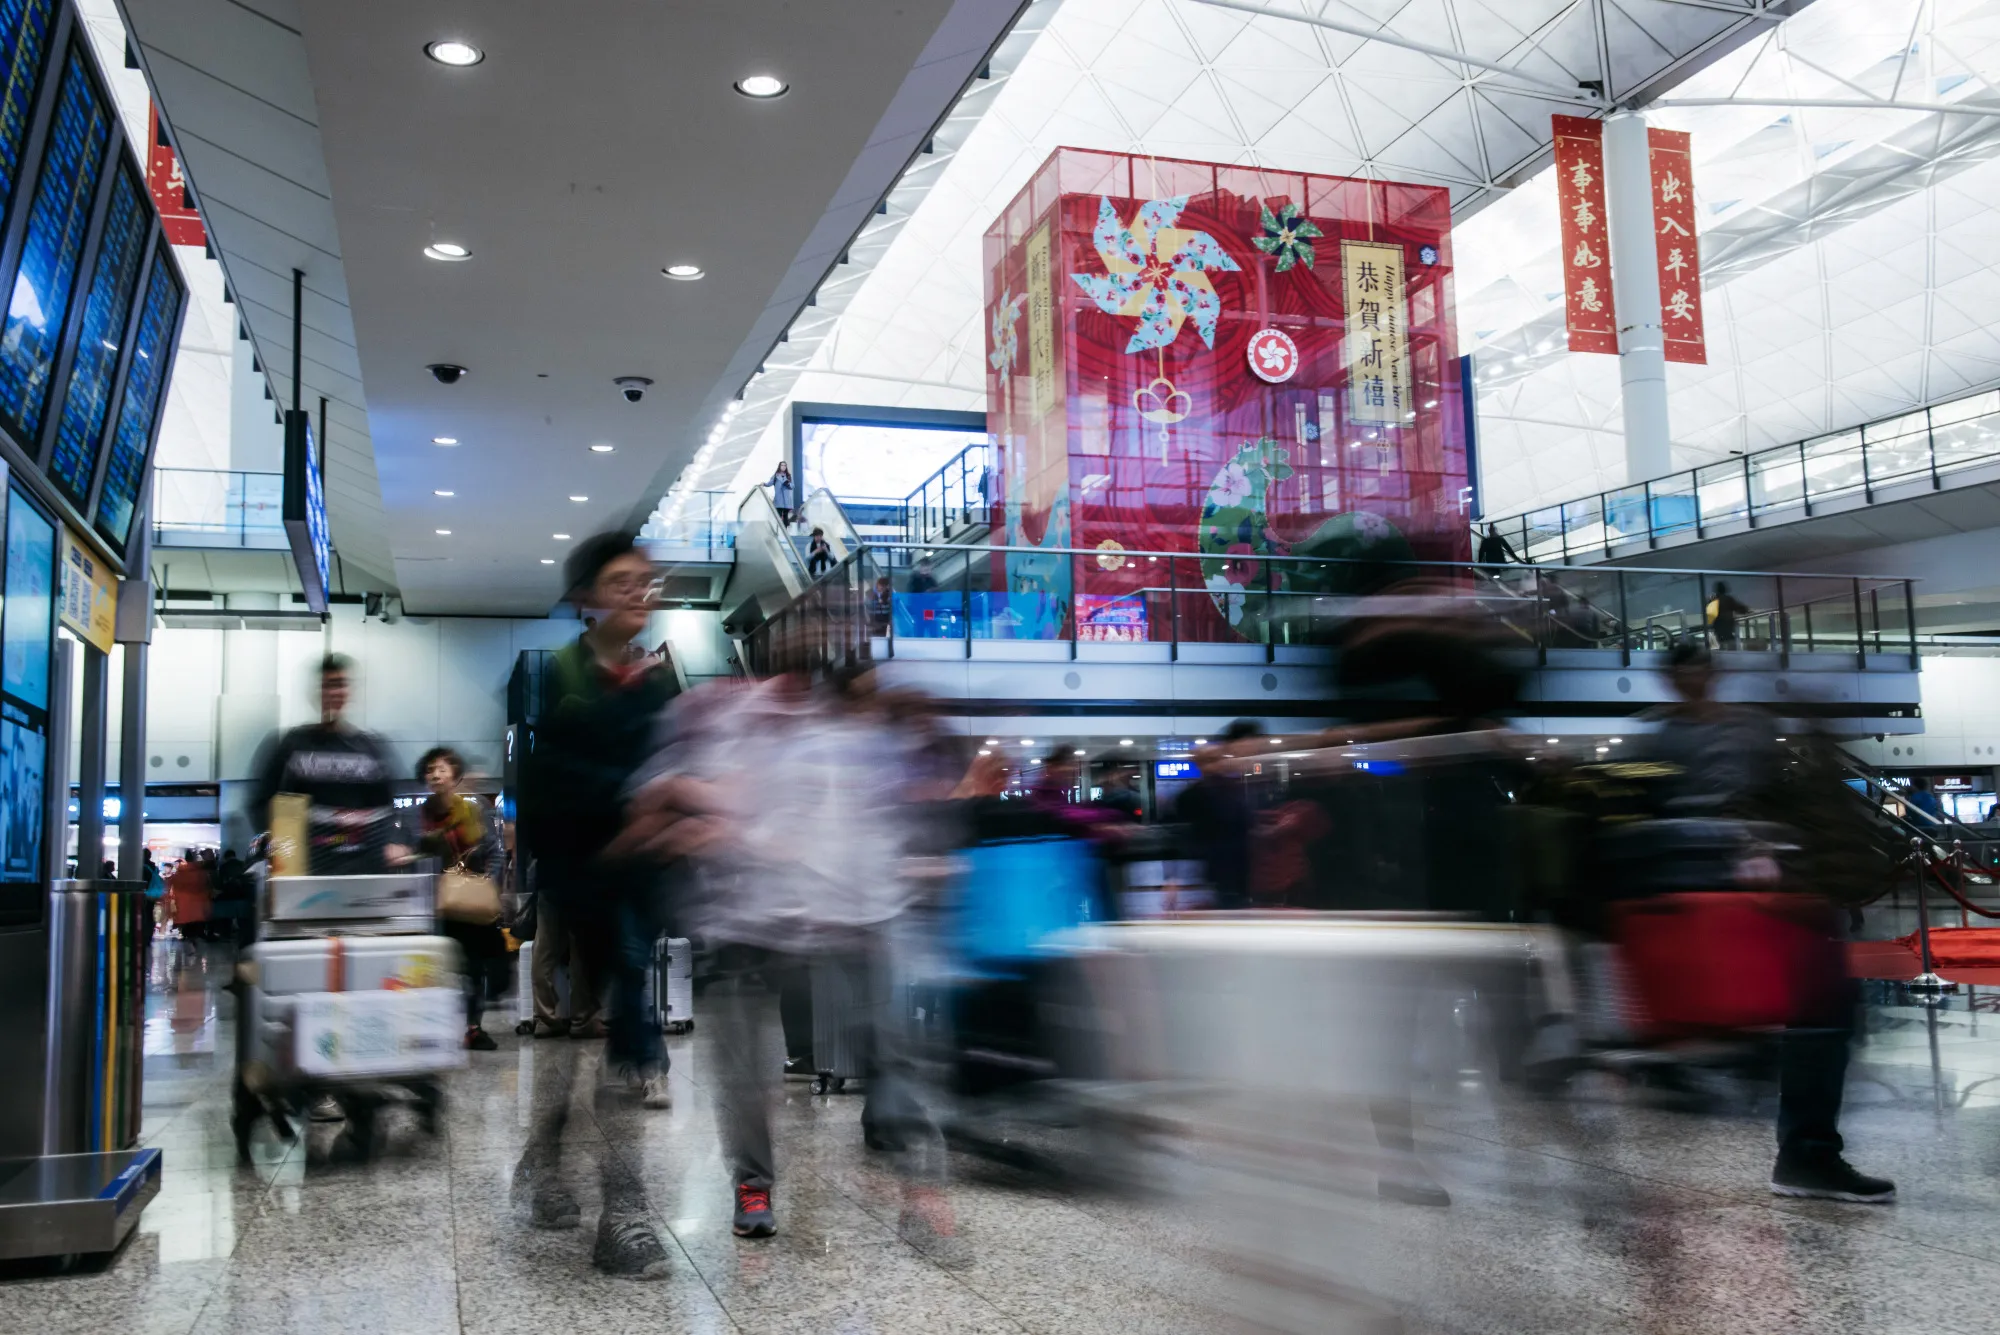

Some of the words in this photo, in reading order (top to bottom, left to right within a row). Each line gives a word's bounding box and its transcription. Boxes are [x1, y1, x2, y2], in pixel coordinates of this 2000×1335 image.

[1569, 158, 1603, 312] 事事如意
[1661, 170, 1695, 322] 出入平安
[1384, 264, 1395, 303] Happy
[1356, 261, 1385, 407] 恭賀新禧
[1388, 304, 1397, 352] Chinese
[1390, 354, 1400, 381] New
[1392, 385, 1402, 410] Year
